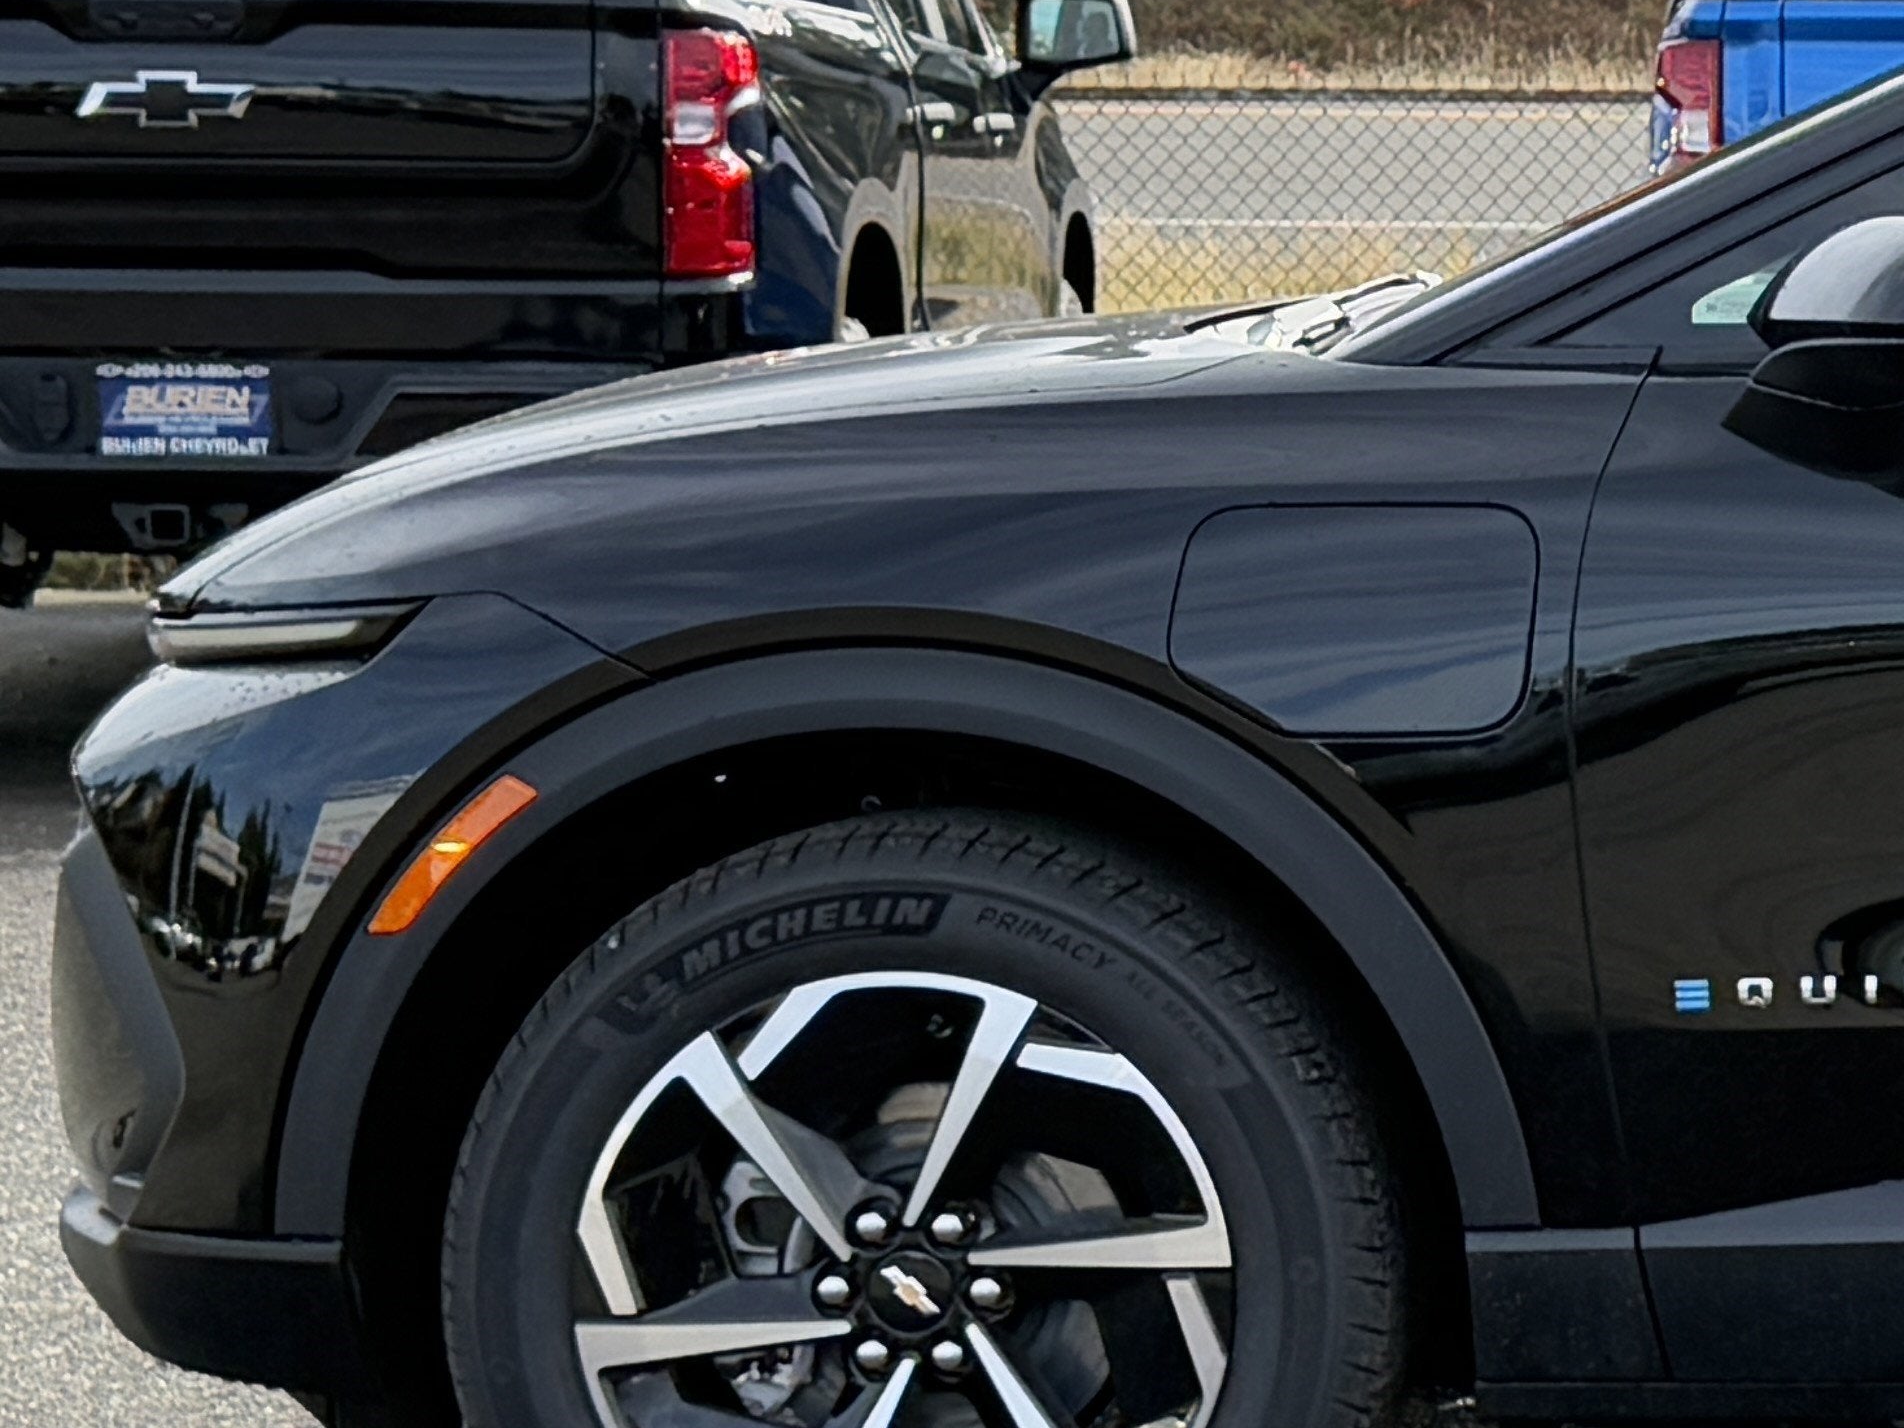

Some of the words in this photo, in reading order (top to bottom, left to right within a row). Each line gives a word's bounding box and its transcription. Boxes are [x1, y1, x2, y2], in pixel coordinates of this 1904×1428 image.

[125, 384, 250, 415] BURIEN
[682, 897, 935, 980] MICHELIN
[974, 905, 1118, 970] PRIMACY
